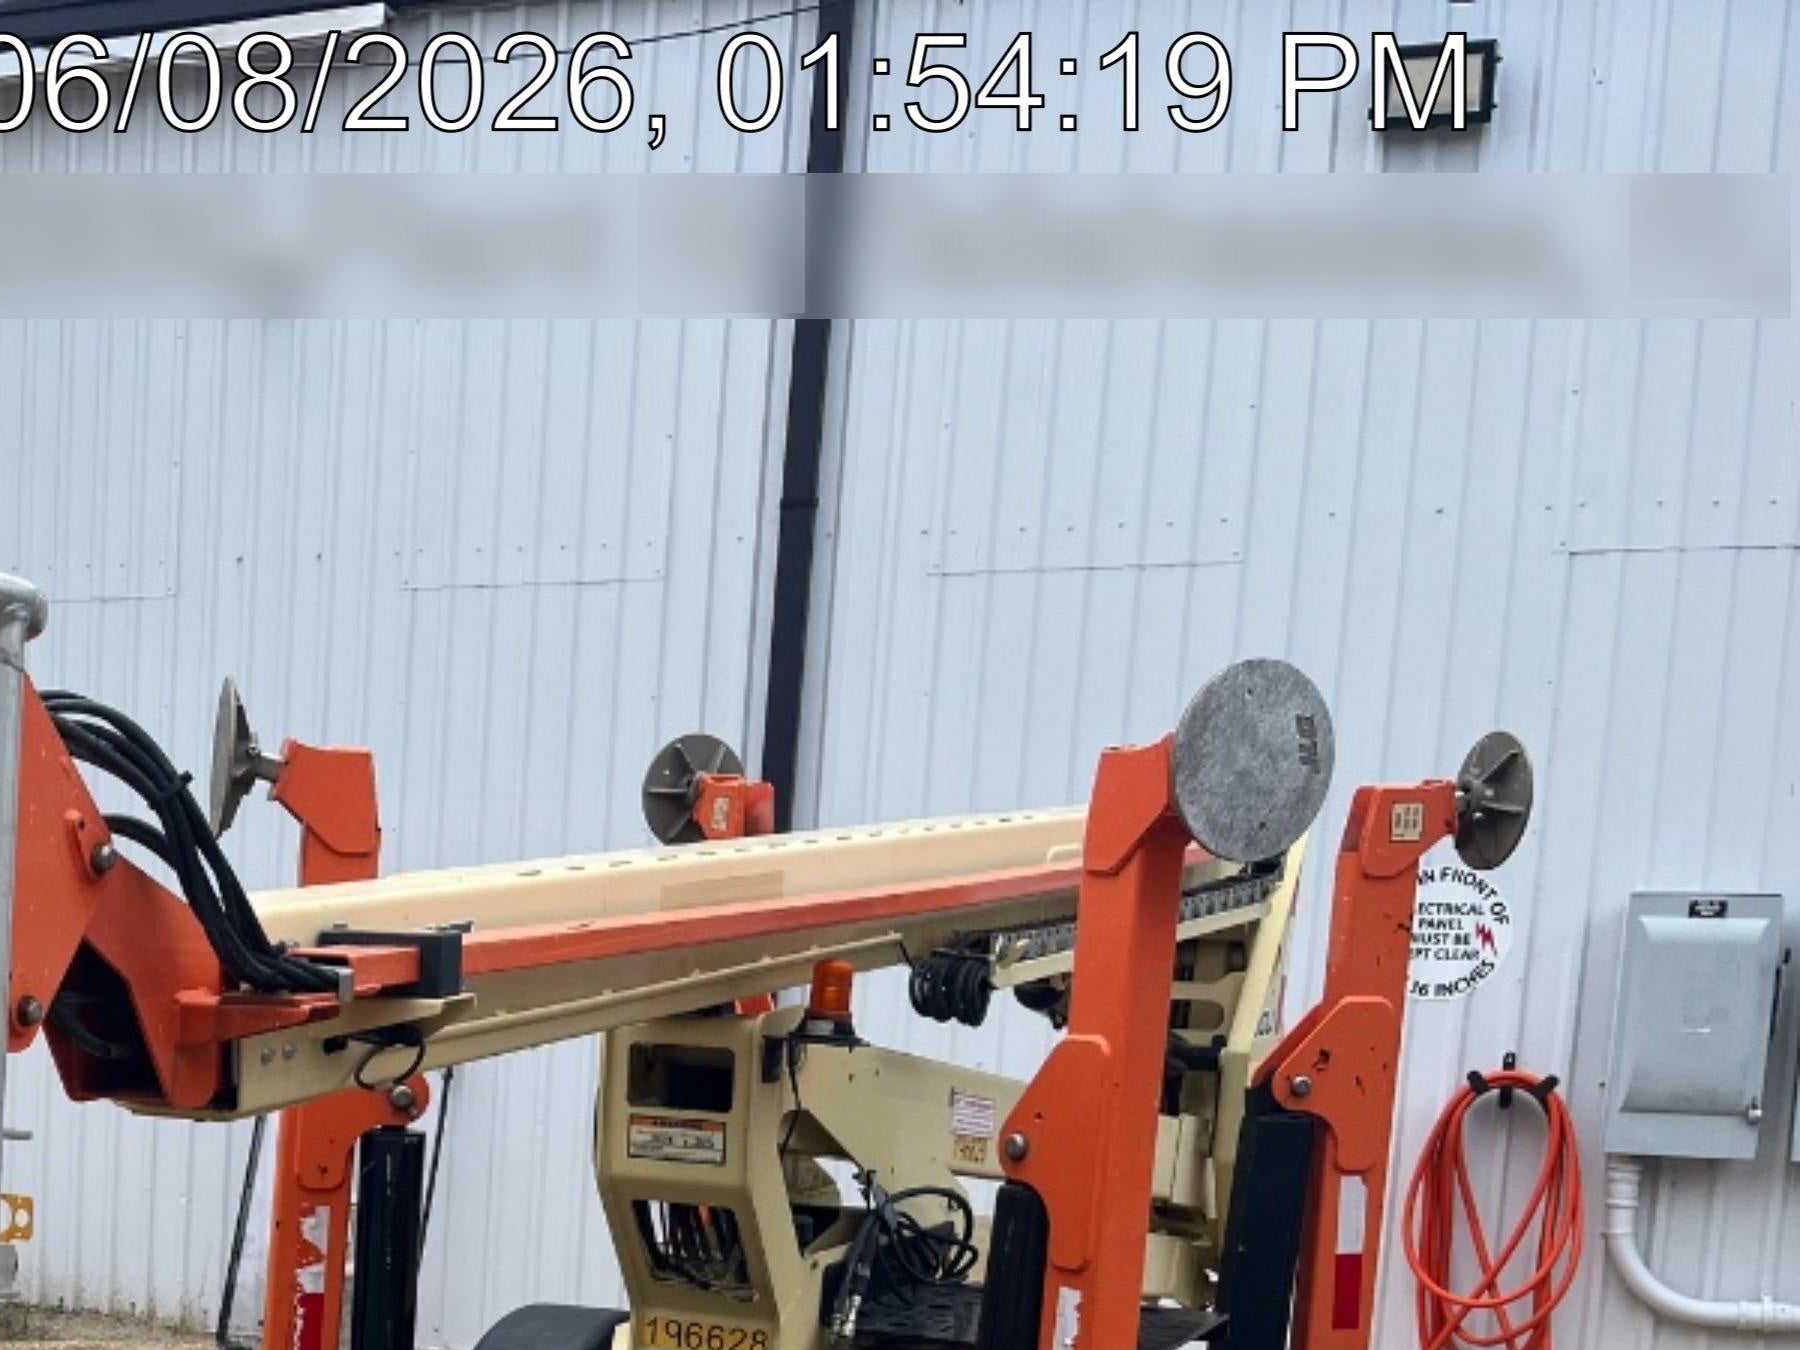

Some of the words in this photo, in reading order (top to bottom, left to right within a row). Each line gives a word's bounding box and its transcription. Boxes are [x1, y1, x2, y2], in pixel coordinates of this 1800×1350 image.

[1490, 902, 1510, 925] OF
[1417, 918, 1463, 930] PANEL
[1454, 933, 1471, 945] BE
[1434, 948, 1479, 961] CLEAR
